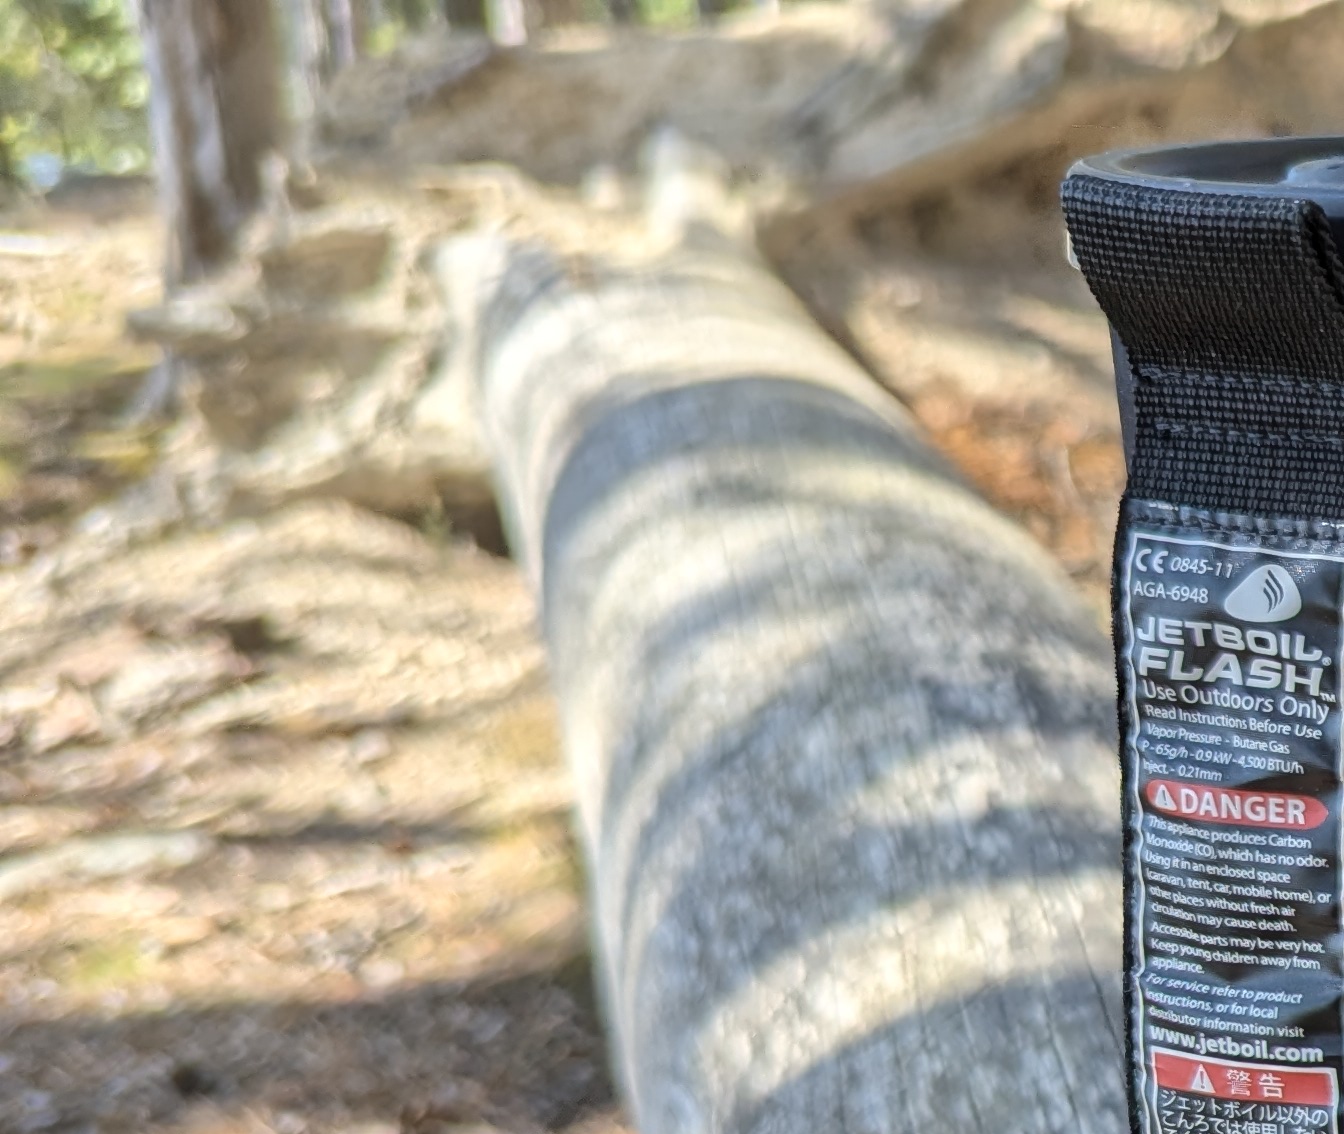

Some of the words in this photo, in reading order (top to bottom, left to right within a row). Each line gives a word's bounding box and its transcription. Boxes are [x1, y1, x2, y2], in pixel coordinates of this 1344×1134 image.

[1171, 557, 1233, 579] 0845-11
[1134, 580, 1209, 604] AGA-6948
[1143, 679, 1177, 701] Use
[1181, 684, 1274, 713] Outdoors
[1280, 696, 1329, 725] Only
[1144, 704, 1176, 720] Read
[1179, 708, 1247, 730] Instructions
[1249, 718, 1291, 736] Before
[1295, 724, 1322, 740] Use
[1147, 722, 1177, 739] Vapor
[1178, 728, 1222, 746] Pressure
[1233, 735, 1267, 752] Butane
[1269, 740, 1290, 754] Gas
[1142, 740, 1150, 752] P
[1156, 743, 1188, 760] 65g/h
[1214, 753, 1232, 765] kW
[1238, 756, 1266, 770] 4,500
[1267, 759, 1304, 775] BTU/h
[1181, 788, 1306, 825] DANGER
[1149, 815, 1166, 830] This
[1167, 822, 1210, 840] appliance
[1211, 831, 1267, 846] produces
[1268, 834, 1312, 849] Carbon
[1145, 849, 1171, 870] Using
[1172, 857, 1180, 869] it
[1181, 858, 1191, 870] in
[1192, 862, 1205, 873] an
[1206, 865, 1256, 880] enclosed
[1257, 871, 1291, 883] space
[1146, 832, 1194, 853] Monoxide
[1218, 848, 1253, 861] which
[1255, 850, 1277, 864] has
[1279, 855, 1294, 866] no
[1296, 854, 1330, 868] odor.
[1173, 891, 1204, 908] places
[1205, 898, 1250, 914] without
[1250, 901, 1280, 915] fresh
[1281, 905, 1297, 917] air
[1187, 877, 1212, 892] tent,
[1233, 885, 1273, 899] mobile
[1273, 887, 1316, 905] home),
[1317, 893, 1332, 904] or
[1150, 922, 1200, 942] Accessible
[1200, 934, 1229, 947] parts
[1229, 937, 1257, 951] may
[1257, 937, 1275, 950] be
[1275, 941, 1302, 954] very
[1302, 940, 1326, 954] hot.
[1197, 913, 1223, 929] may
[1224, 917, 1257, 930] cause
[1258, 919, 1298, 932] death.
[1151, 938, 1180, 955] Keep
[1180, 944, 1212, 962] young
[1212, 950, 1260, 965] children
[1260, 955, 1292, 970] away
[1292, 956, 1321, 970] from
[1151, 957, 1205, 975] appliance.
[1146, 972, 1167, 985] For
[1166, 978, 1210, 994] service
[1211, 985, 1241, 998] refer
[1241, 989, 1255, 999] to
[1254, 991, 1303, 1004] product
[1215, 1003, 1230, 1014] or
[1230, 1002, 1248, 1016] for
[1249, 1004, 1279, 1019] local
[1202, 1017, 1275, 1036] information
[1276, 1026, 1305, 1038] visit
[1150, 1025, 1324, 1063] www.jetboil.com
[1226, 1069, 1286, 1099] 警告
[1160, 1089, 1329, 1127] ジェットボイル以外の
